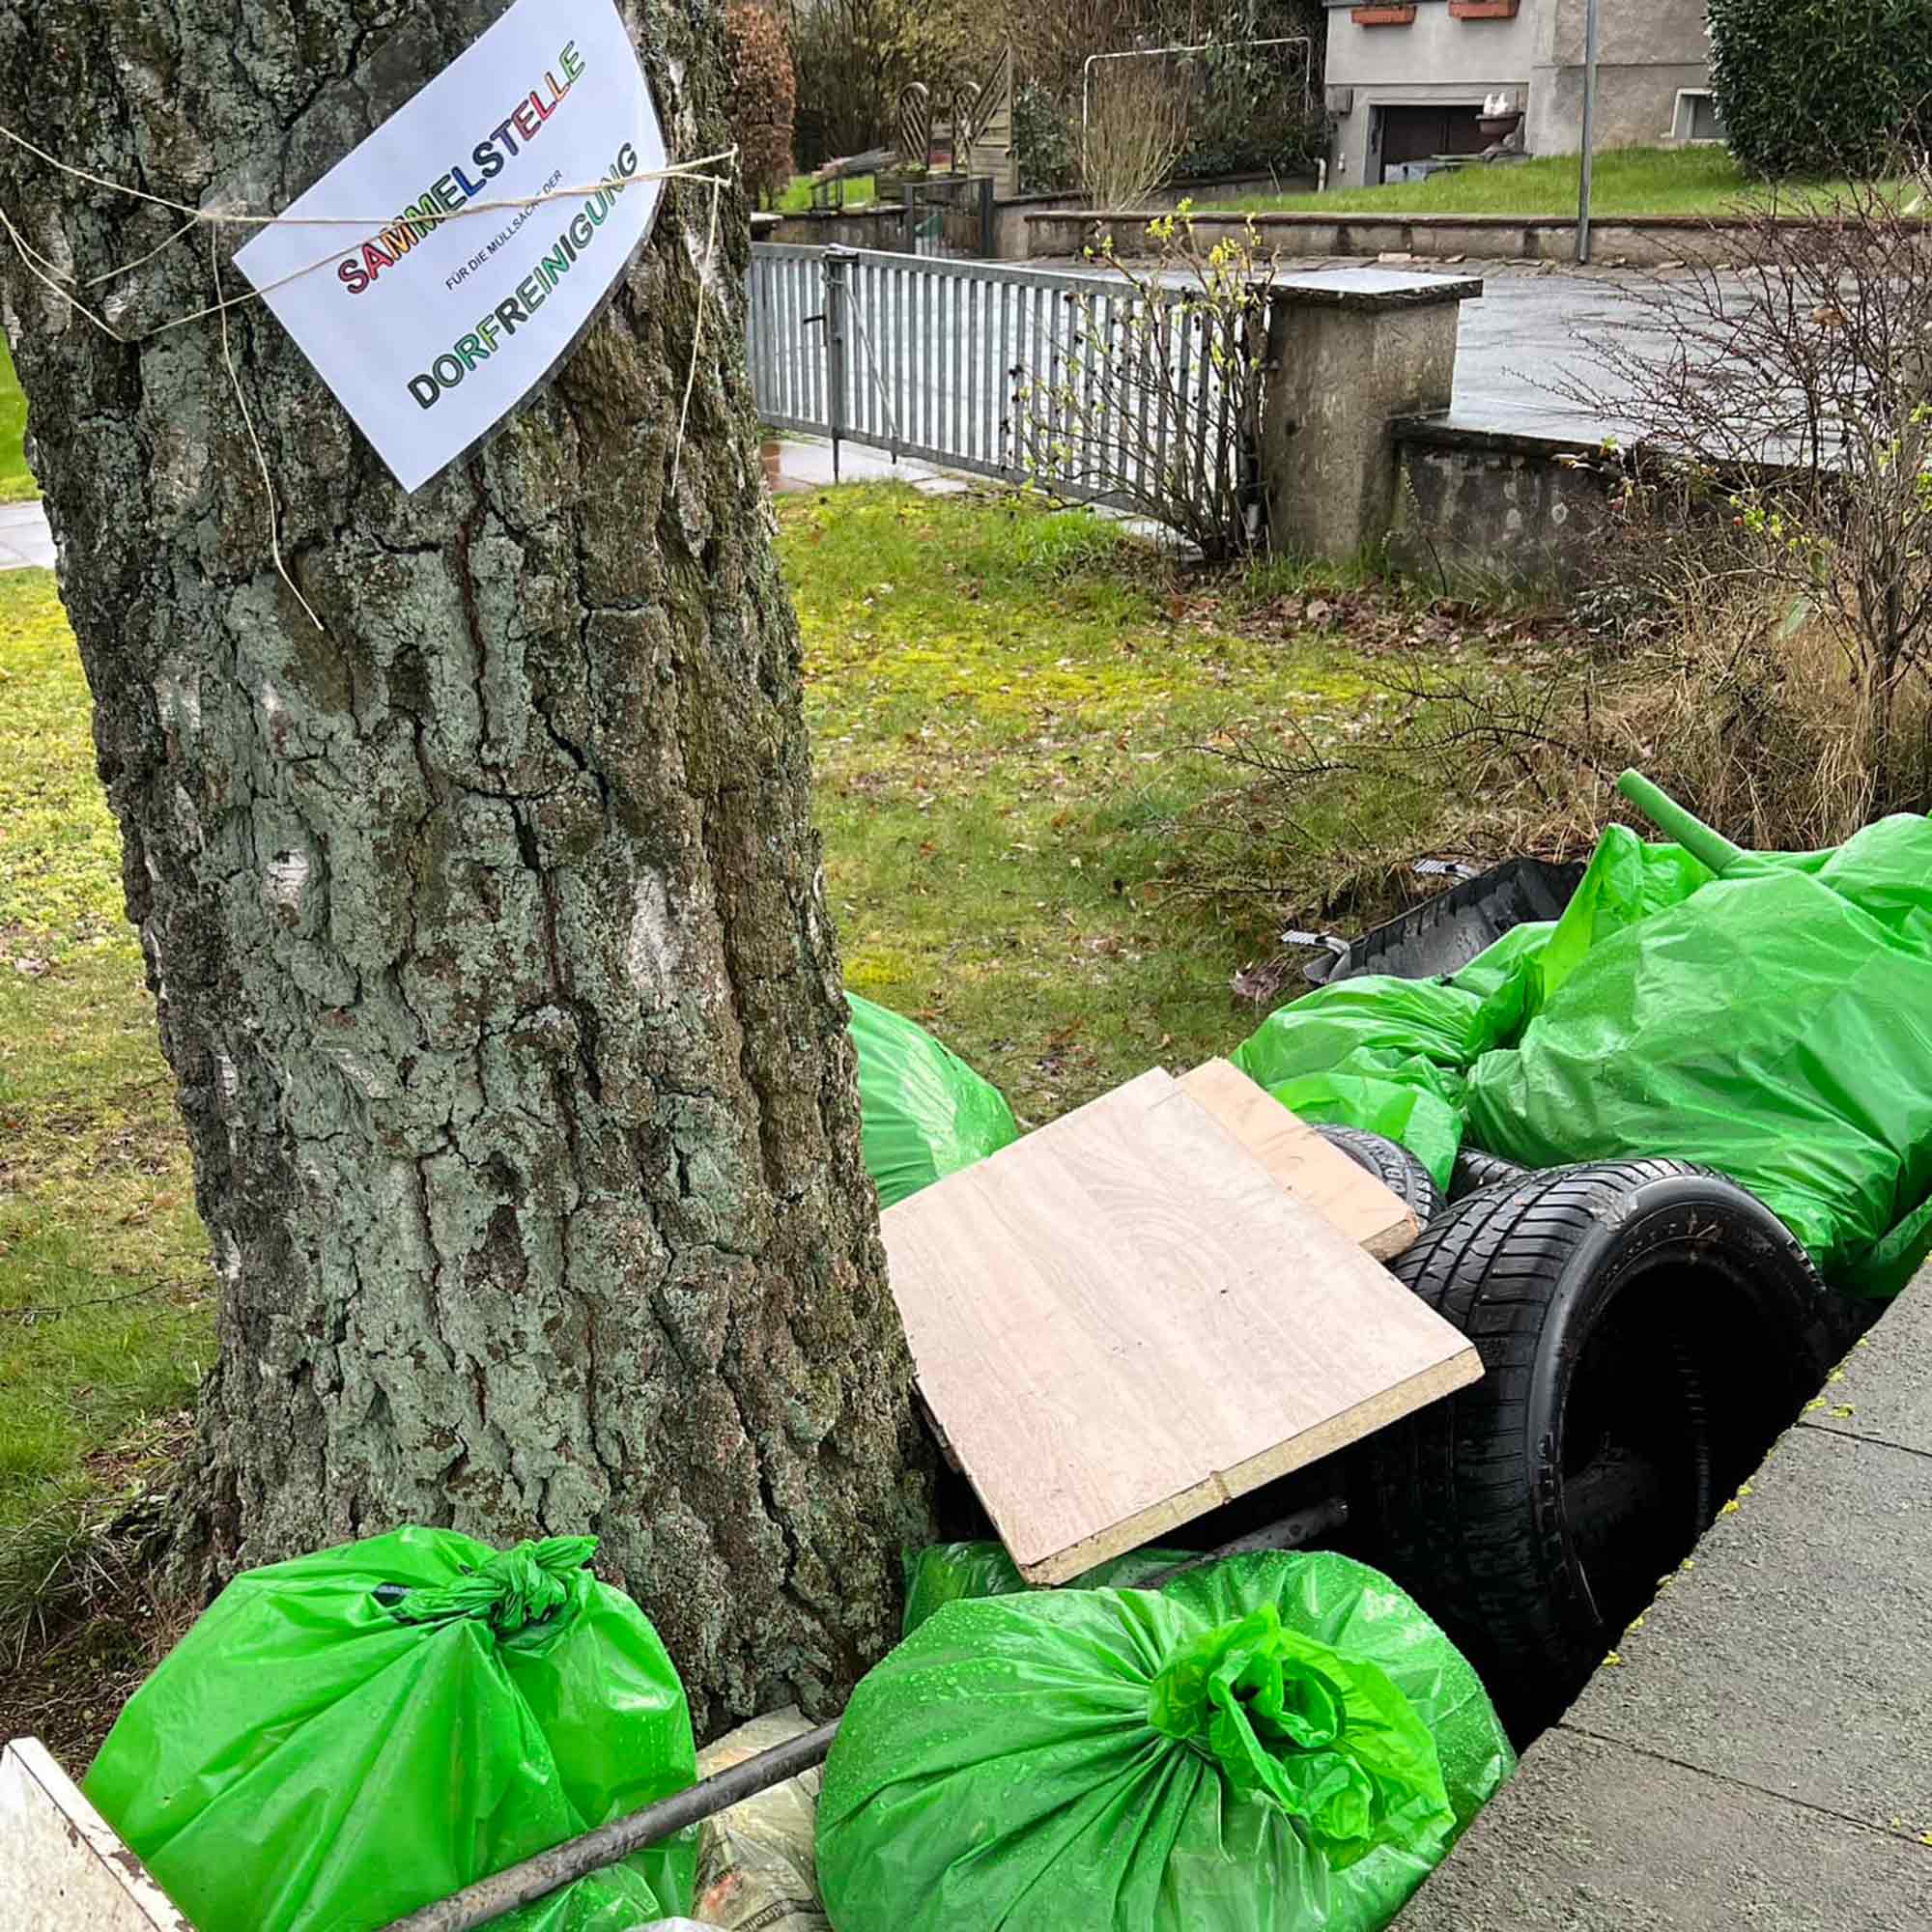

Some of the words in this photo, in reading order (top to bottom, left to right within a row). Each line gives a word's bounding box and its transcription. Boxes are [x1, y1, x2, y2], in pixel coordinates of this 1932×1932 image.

[337, 40, 586, 295] SAMMELSTELLE
[406, 141, 639, 411] DORFREINIGUNG
[468, 248, 489, 271] DIE
[542, 169, 563, 195] DER
